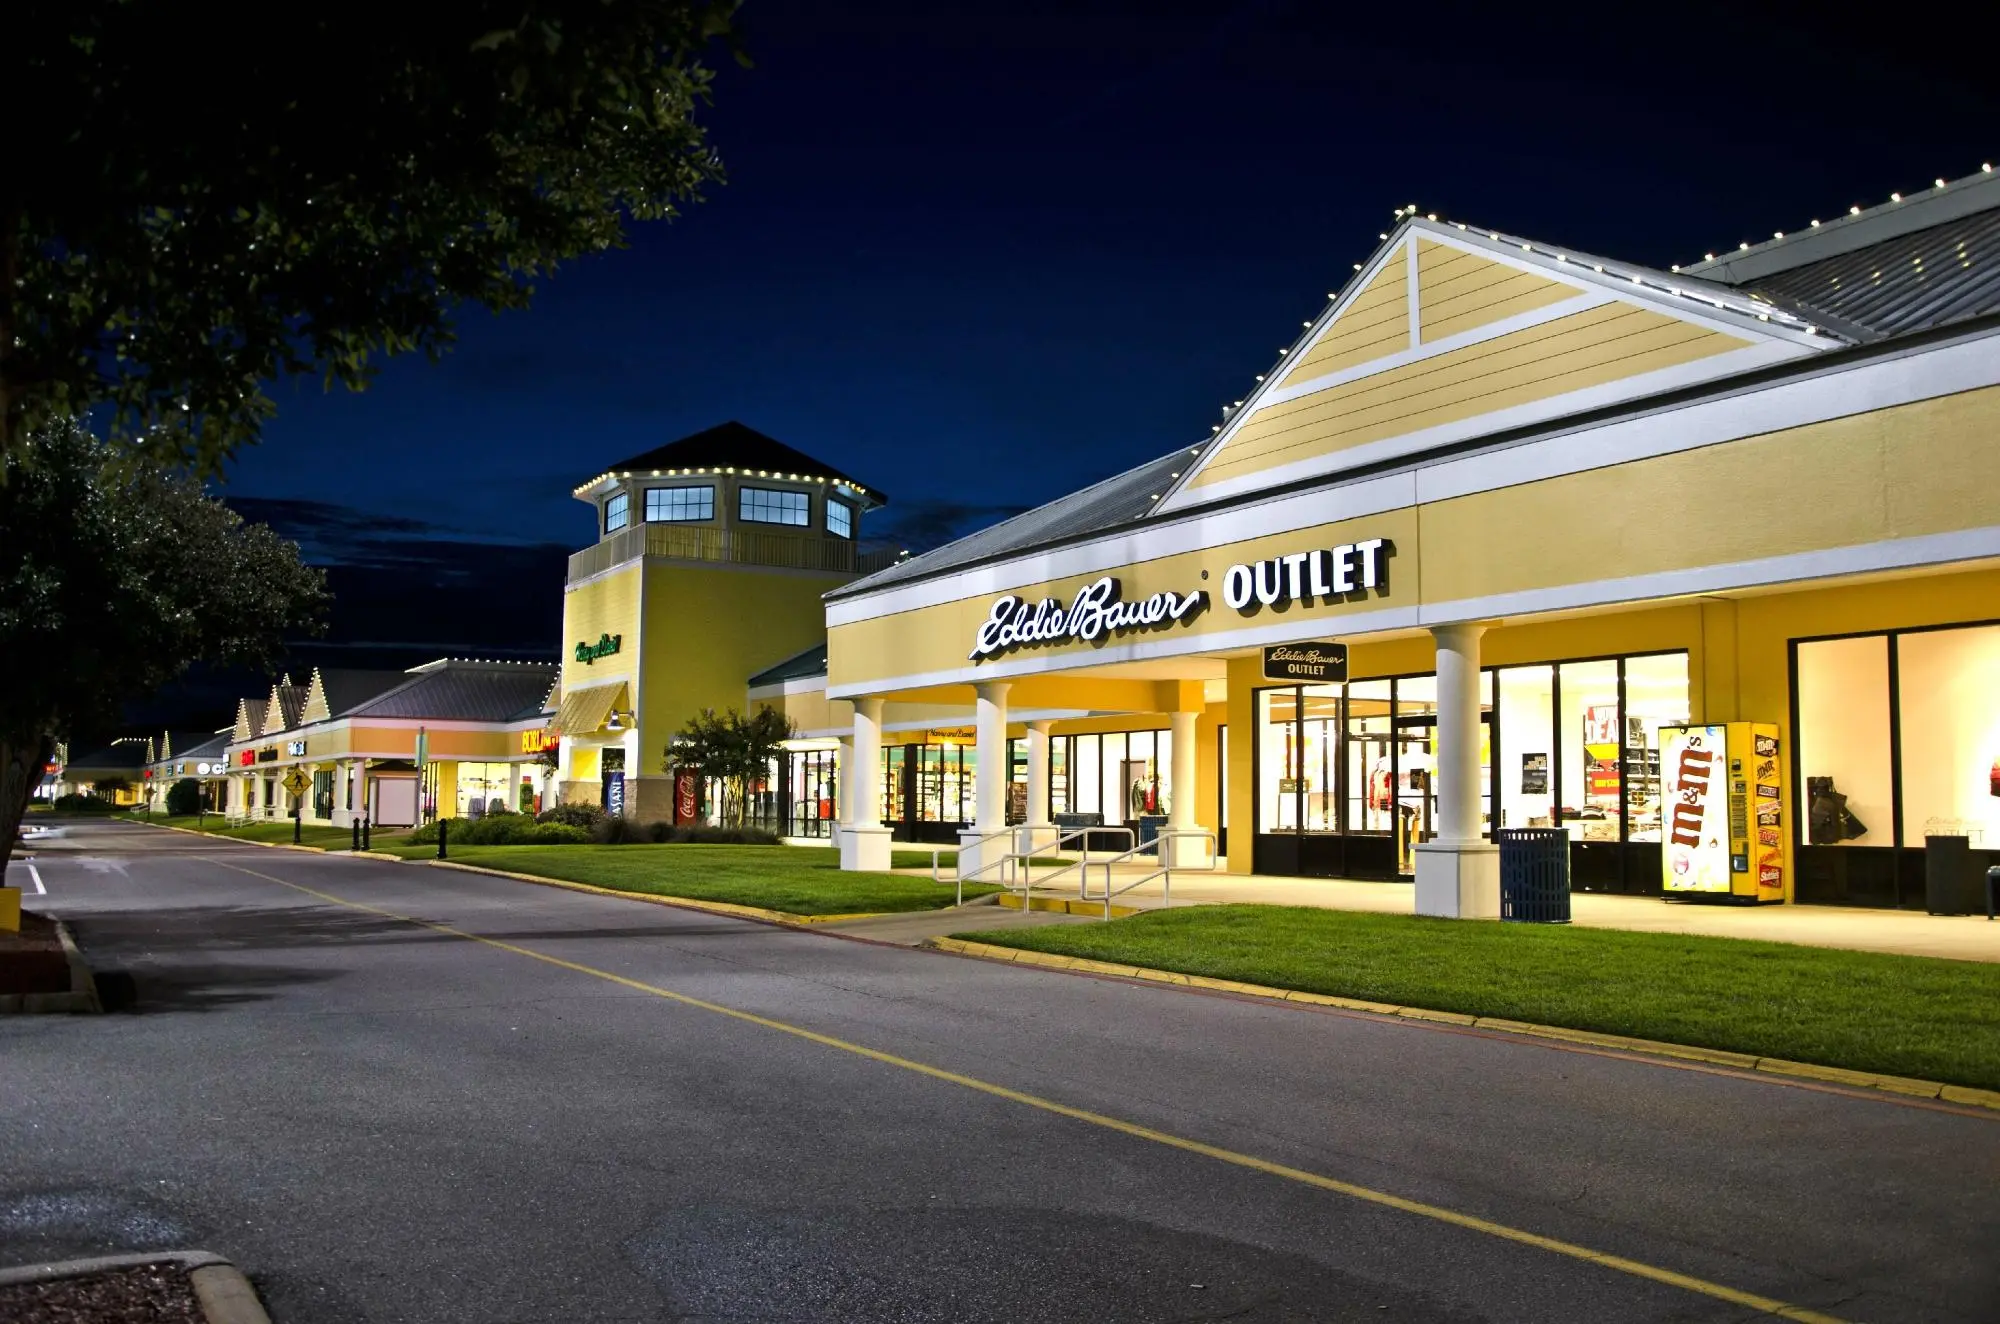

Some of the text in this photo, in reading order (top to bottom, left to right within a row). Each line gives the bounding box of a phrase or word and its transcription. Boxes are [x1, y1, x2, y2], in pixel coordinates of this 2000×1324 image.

[1223, 538, 1385, 609] OUTLET
[969, 577, 1200, 660] Eddie Bauer
[1268, 647, 1344, 664] Eddie Bauer
[1288, 663, 1325, 675] OUTLET
[1585, 719, 1619, 744] DEA
[611, 782, 623, 819] ASANI
